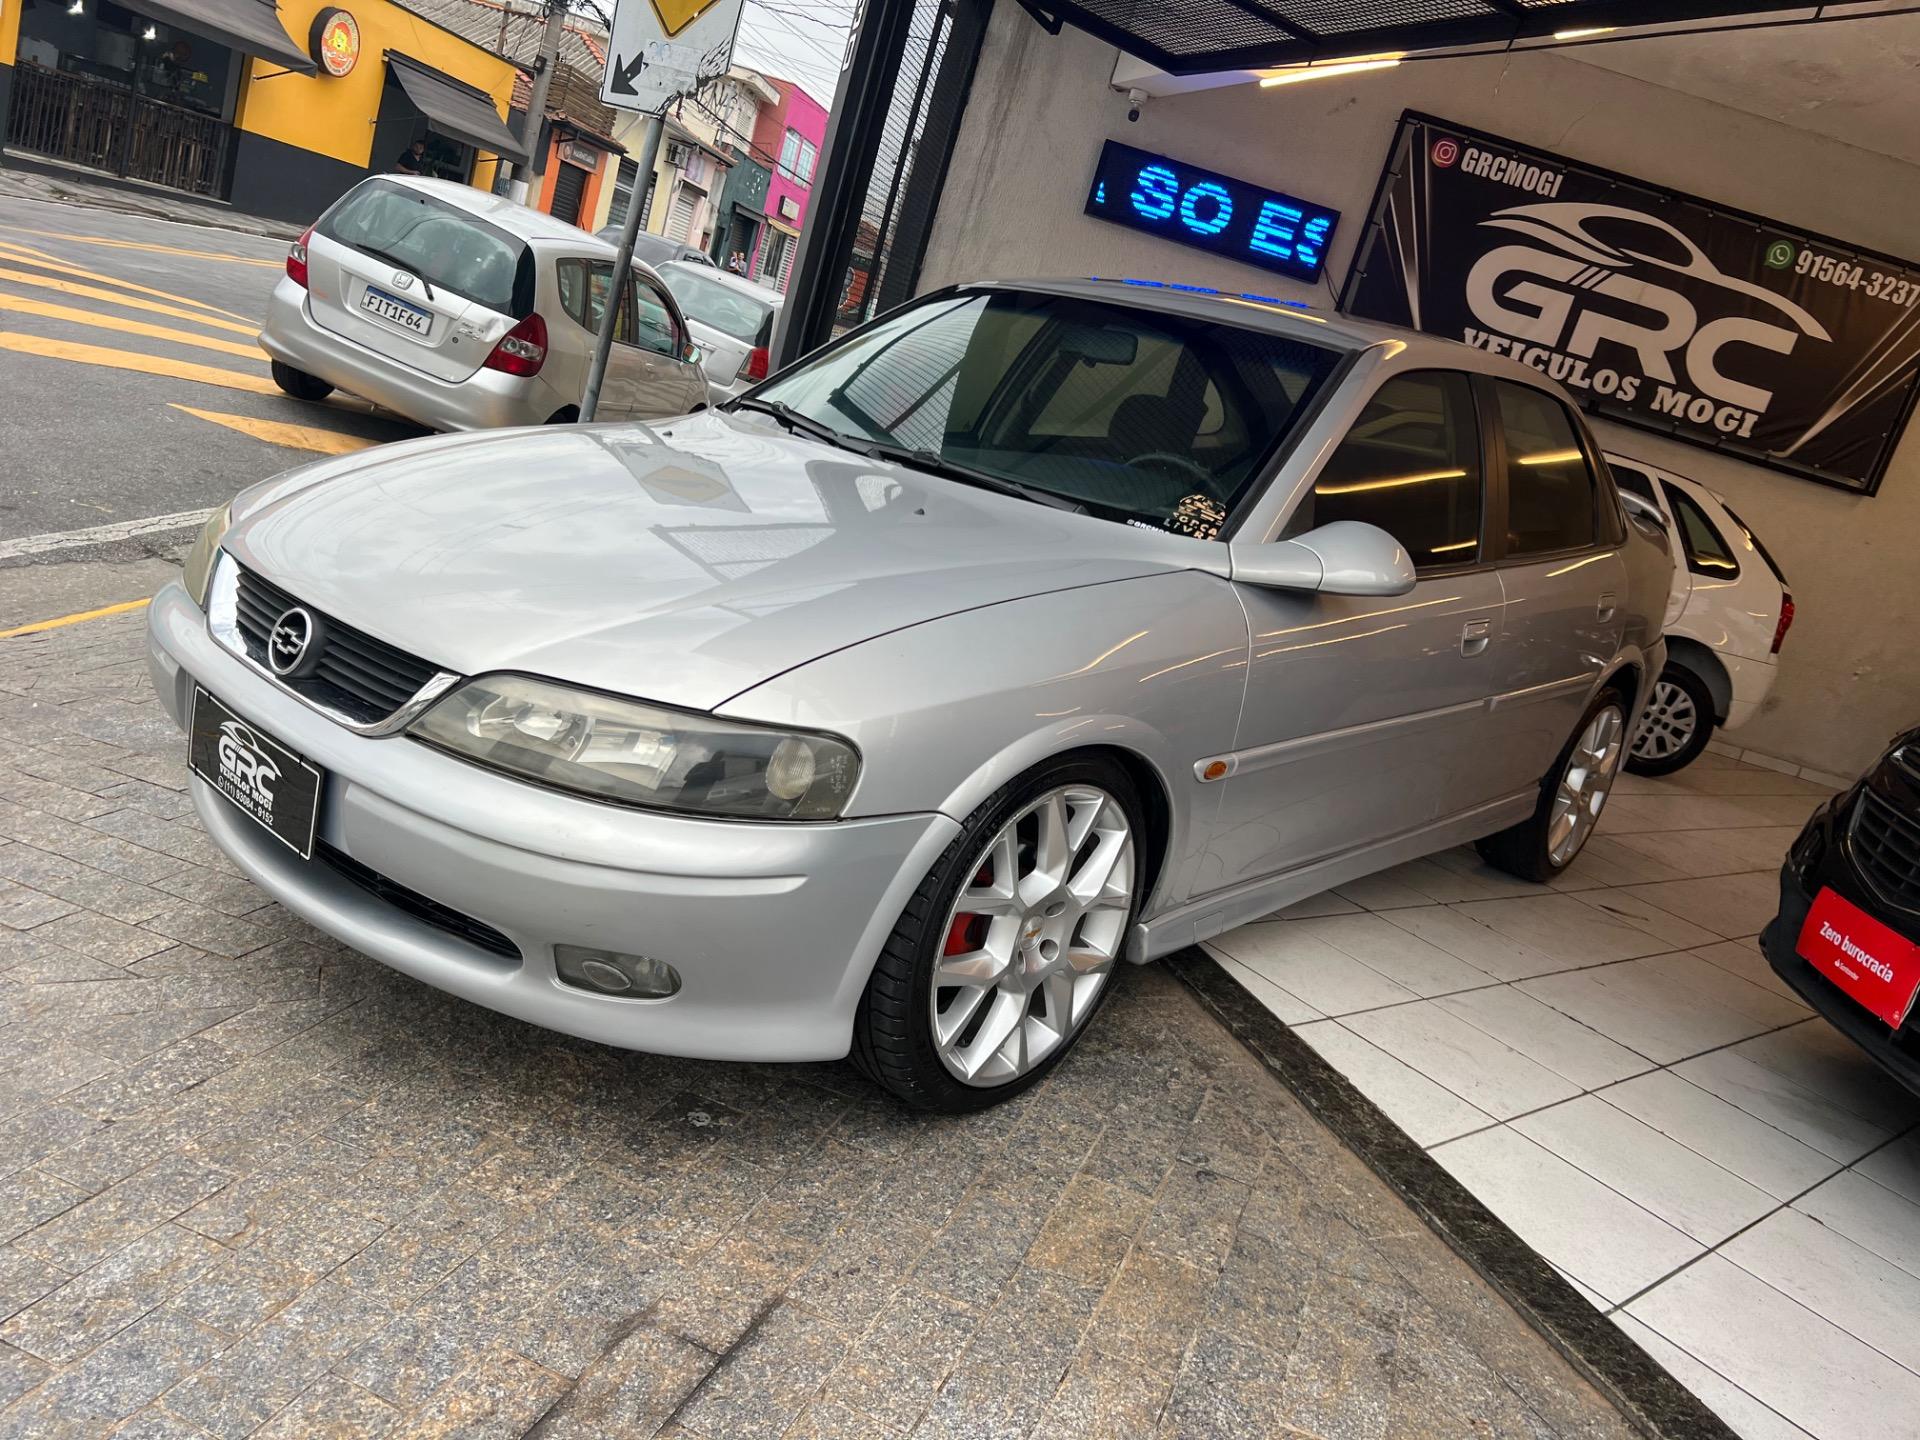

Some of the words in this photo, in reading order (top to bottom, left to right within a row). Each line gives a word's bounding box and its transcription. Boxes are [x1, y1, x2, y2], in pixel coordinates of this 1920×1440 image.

[1130, 165, 1233, 235] SO
[1461, 147, 1564, 198] GRCMOGI
[1795, 249, 1920, 308] 91564-3237
[367, 296, 422, 330] FIT1F64
[1466, 245, 1799, 413] GRC
[1650, 386, 1759, 438] MOGI
[219, 735, 275, 802] GRC
[220, 763, 250, 794] VEICULOS
[251, 788, 272, 811] MOGI
[224, 779, 235, 798] (11)
[257, 806, 273, 825] 9152
[1820, 921, 1841, 945] Zero
[1841, 935, 1893, 983] burocracia
